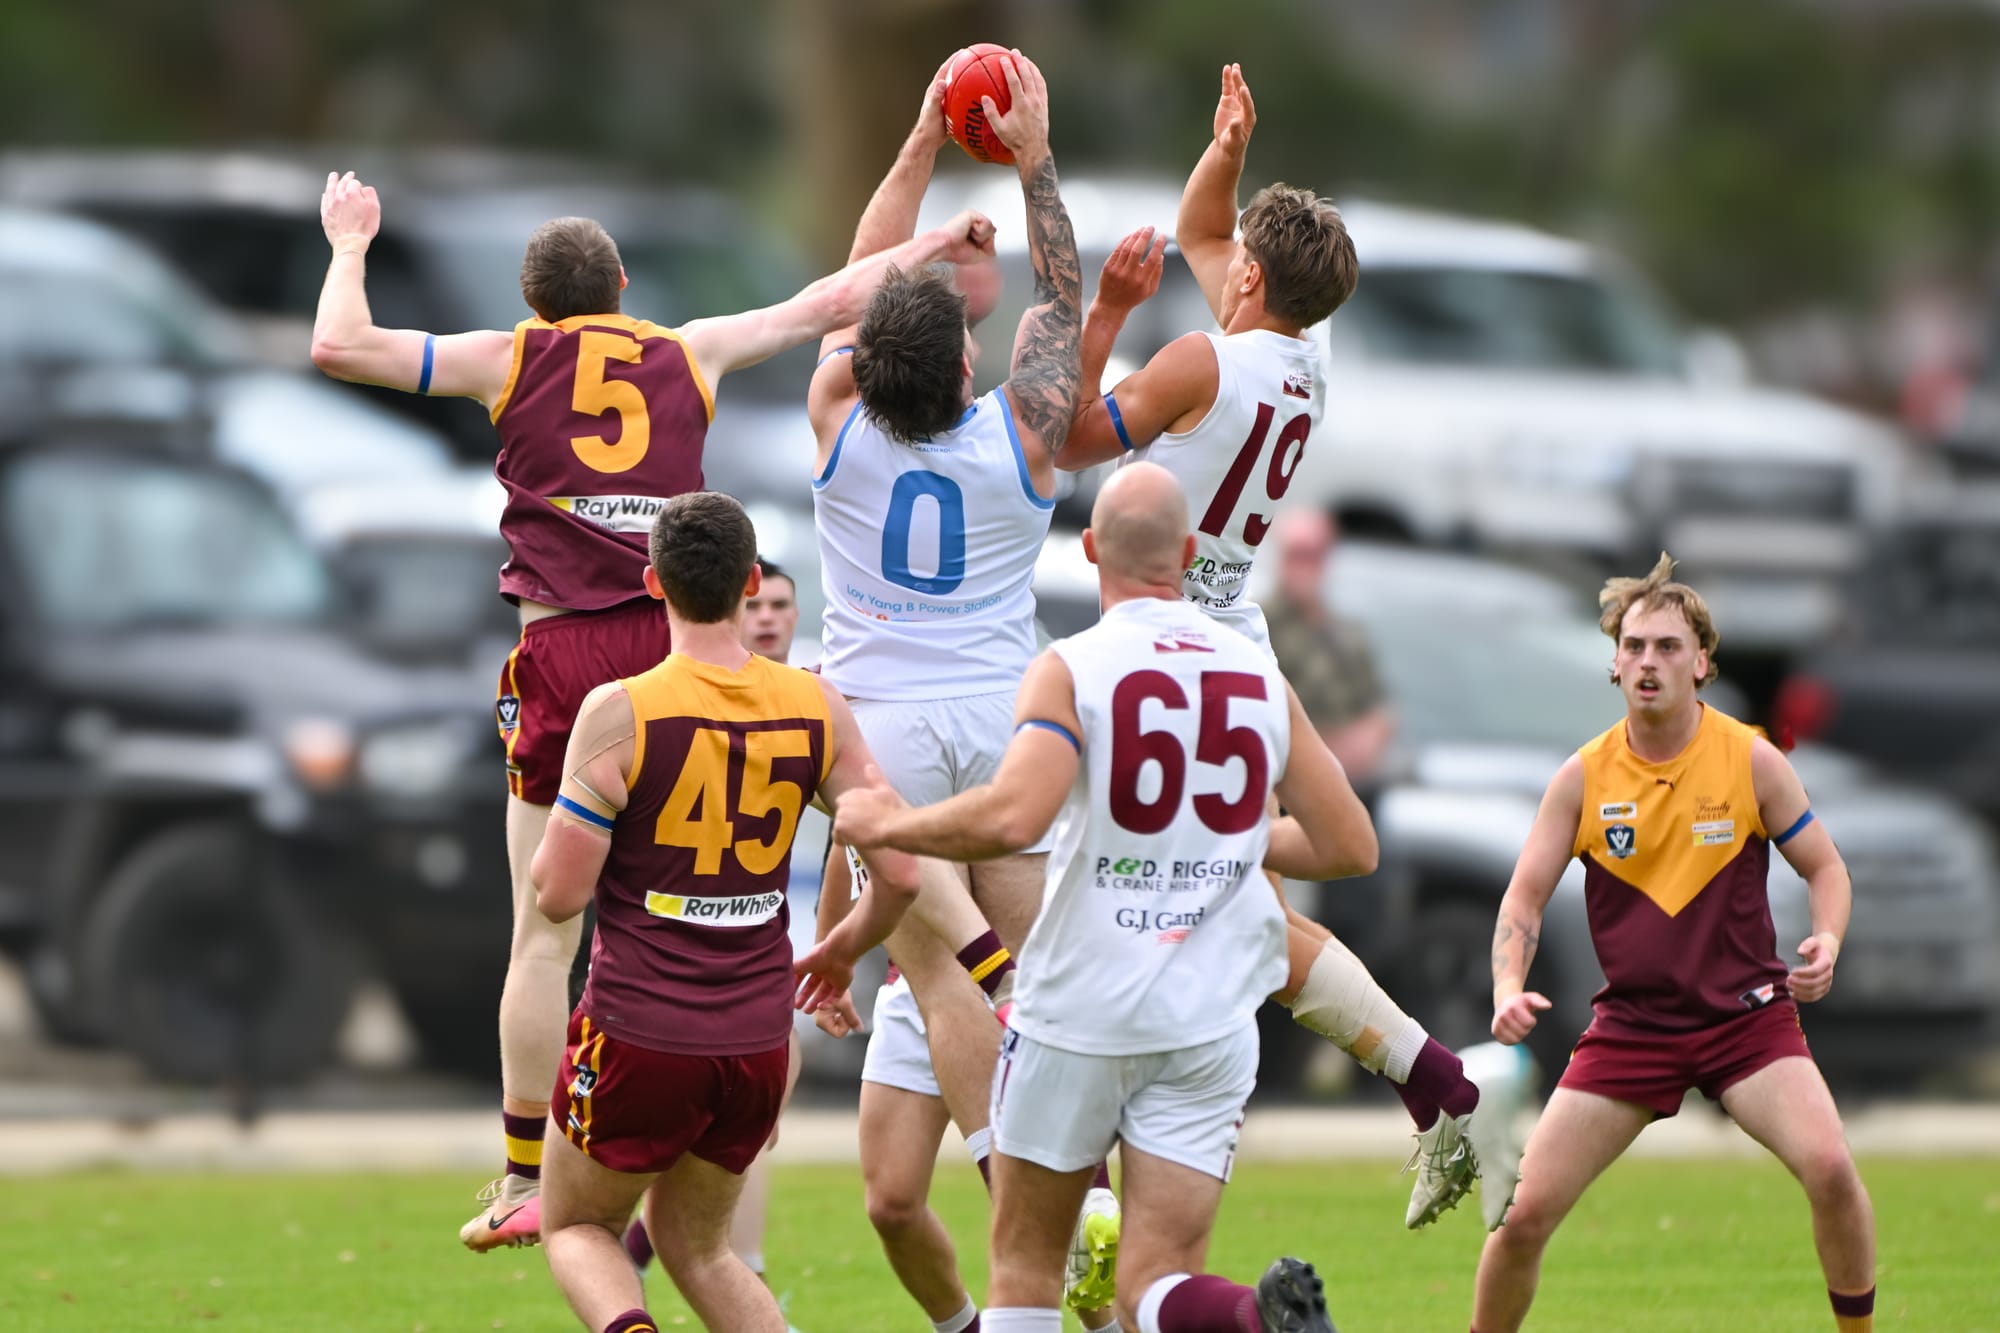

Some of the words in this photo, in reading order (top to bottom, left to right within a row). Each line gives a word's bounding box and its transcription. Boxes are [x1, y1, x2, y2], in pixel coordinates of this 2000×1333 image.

[570, 329, 651, 474] 5
[1198, 402, 1312, 547] 19
[573, 497, 663, 521] RayWhi
[880, 470, 967, 596] 0
[1184, 570, 1214, 586] RANE
[868, 594, 902, 613] Yang
[906, 602, 915, 612] B
[919, 602, 961, 614] Power
[964, 594, 1002, 614] Station
[1109, 668, 1269, 836] 65
[653, 728, 811, 876] 45
[1172, 860, 1254, 880] RIGGIN
[1096, 876, 1106, 888] &
[1112, 878, 1164, 893] CRANE
[1169, 879, 1201, 893] HIRE
[1205, 878, 1235, 892] PTY
[683, 893, 780, 920] RayWhite
[1116, 908, 1150, 934] G.J.
[1155, 906, 1205, 931] Gard
